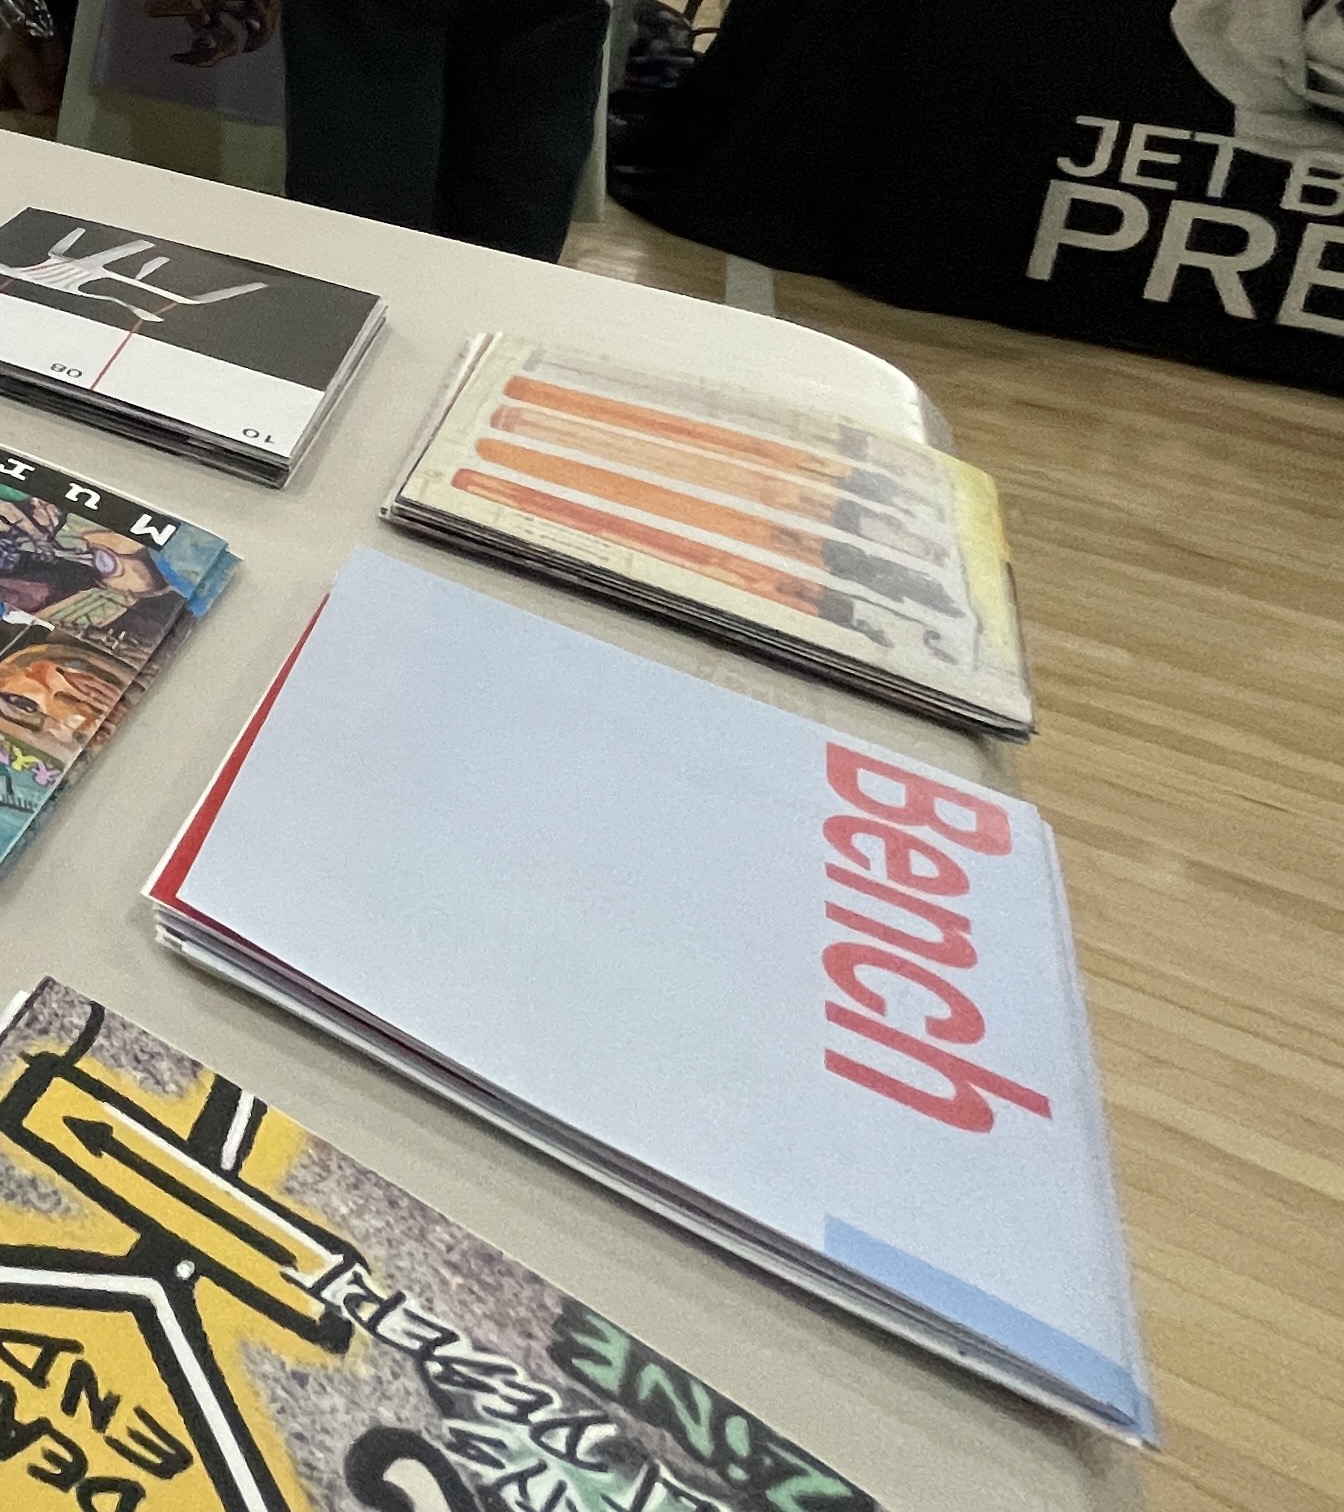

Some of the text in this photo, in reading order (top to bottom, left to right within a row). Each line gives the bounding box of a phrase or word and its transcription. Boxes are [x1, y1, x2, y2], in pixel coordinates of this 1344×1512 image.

[1056, 114, 1239, 200] JET
[1025, 178, 1344, 337] PRE
[50, 362, 83, 380] 08
[242, 427, 276, 445] 10
[823, 740, 1054, 1134] Bench
[280, 1252, 616, 1474] DESERT
